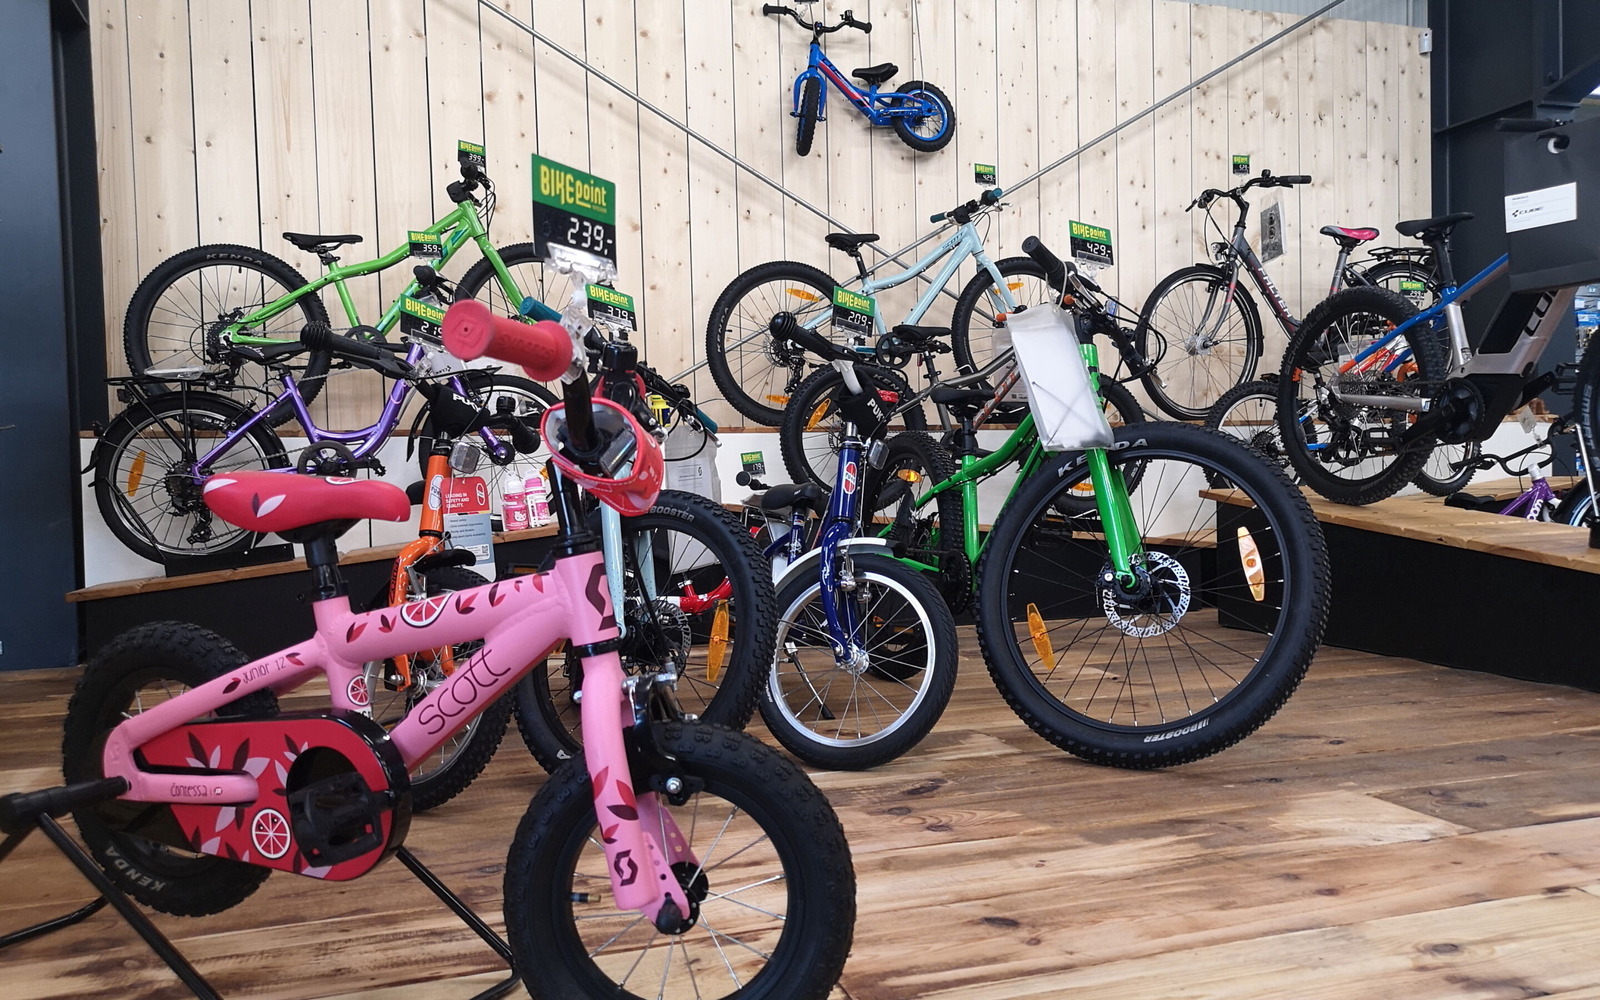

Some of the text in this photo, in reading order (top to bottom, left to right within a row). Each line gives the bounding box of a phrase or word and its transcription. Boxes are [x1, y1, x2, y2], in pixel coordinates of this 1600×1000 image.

[540, 164, 607, 208] BIKEpoint
[1072, 223, 1106, 238] BIKEpoint
[206, 254, 262, 265] KENDA
[590, 285, 629, 304] BIKEpoint
[838, 290, 870, 309] BIKEpoint
[1258, 268, 1292, 318] FALTER
[405, 298, 445, 321] BIKEpoin
[1057, 438, 1148, 478] KEDA
[650, 505, 695, 522] BOOSTER
[275, 657, 286, 671] 12
[1144, 722, 1198, 743] BOOSTER
[106, 846, 166, 891] KENDA
